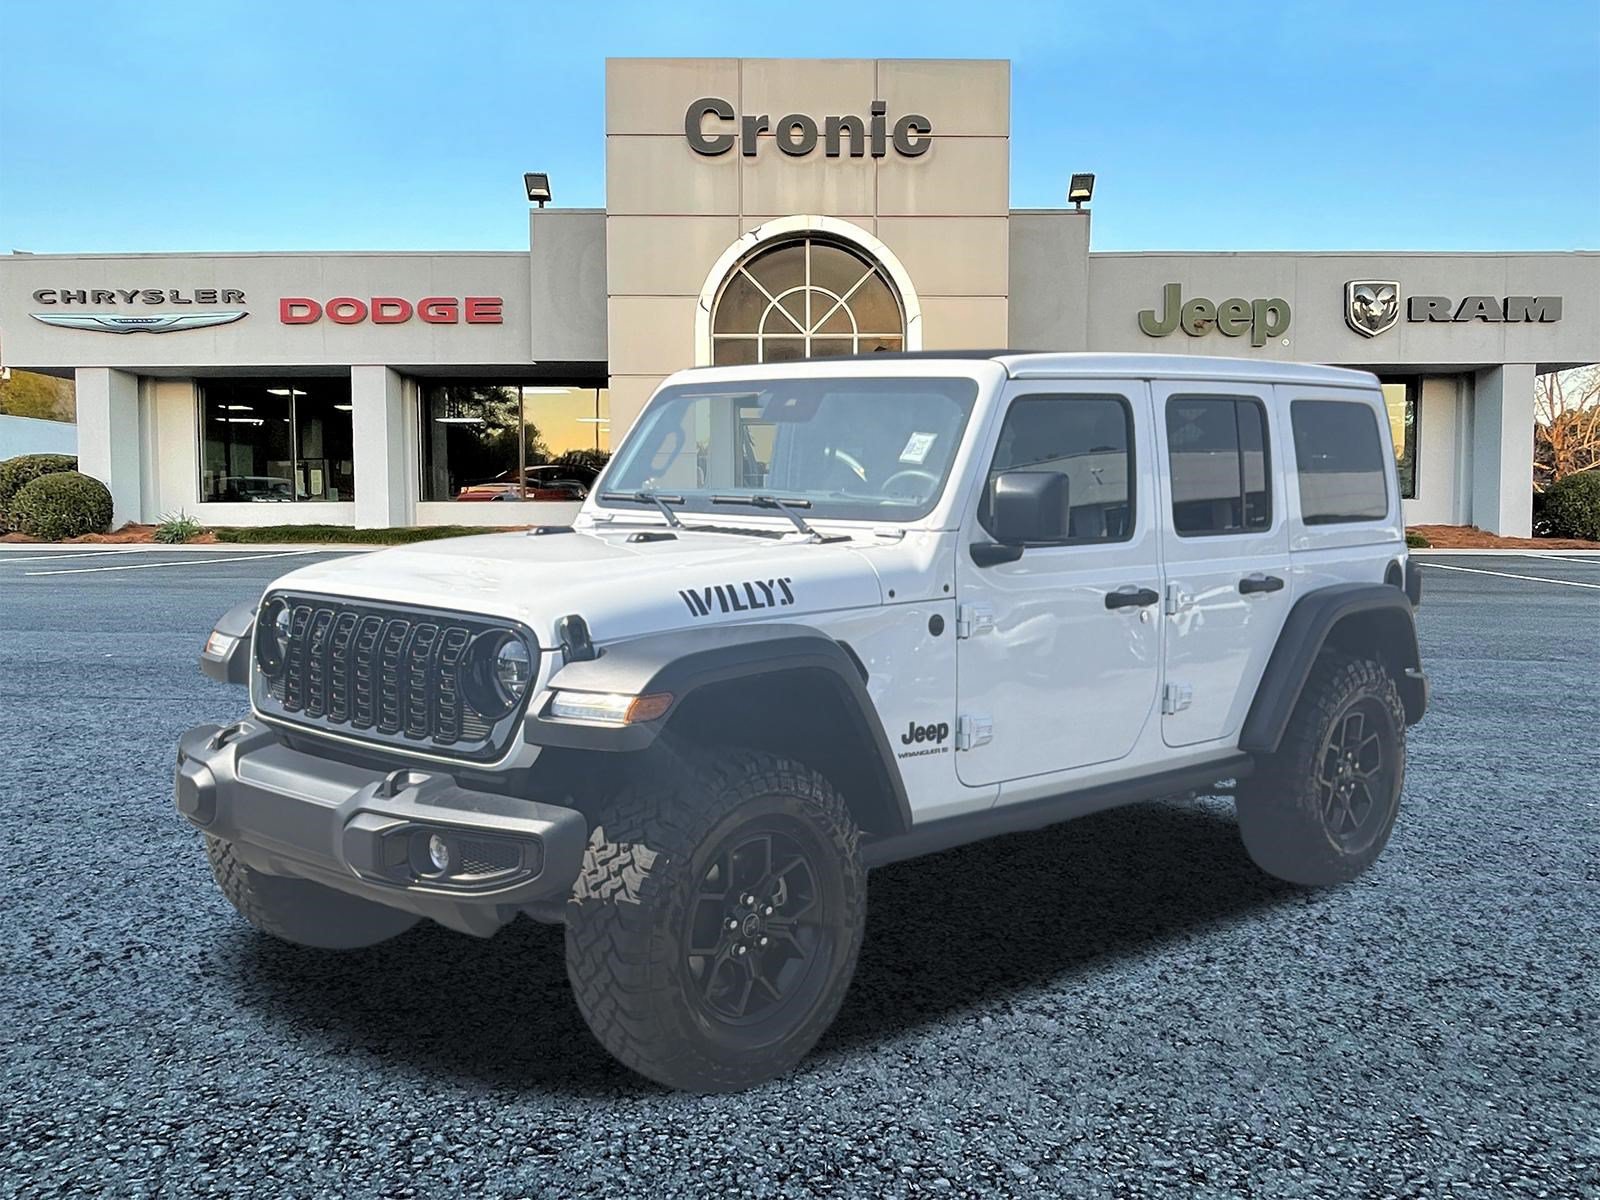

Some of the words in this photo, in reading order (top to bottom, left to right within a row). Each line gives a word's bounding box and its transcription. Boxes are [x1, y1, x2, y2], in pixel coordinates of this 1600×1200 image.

[685, 97, 932, 157] Cronic
[32, 288, 247, 304] CHRYSLER
[1407, 295, 1563, 323] RAM
[280, 297, 504, 325] DODGE
[1138, 283, 1291, 347] Jeep
[679, 577, 794, 617] WILLYS
[901, 721, 949, 745] Jeep
[897, 747, 940, 759] WRANGLER
